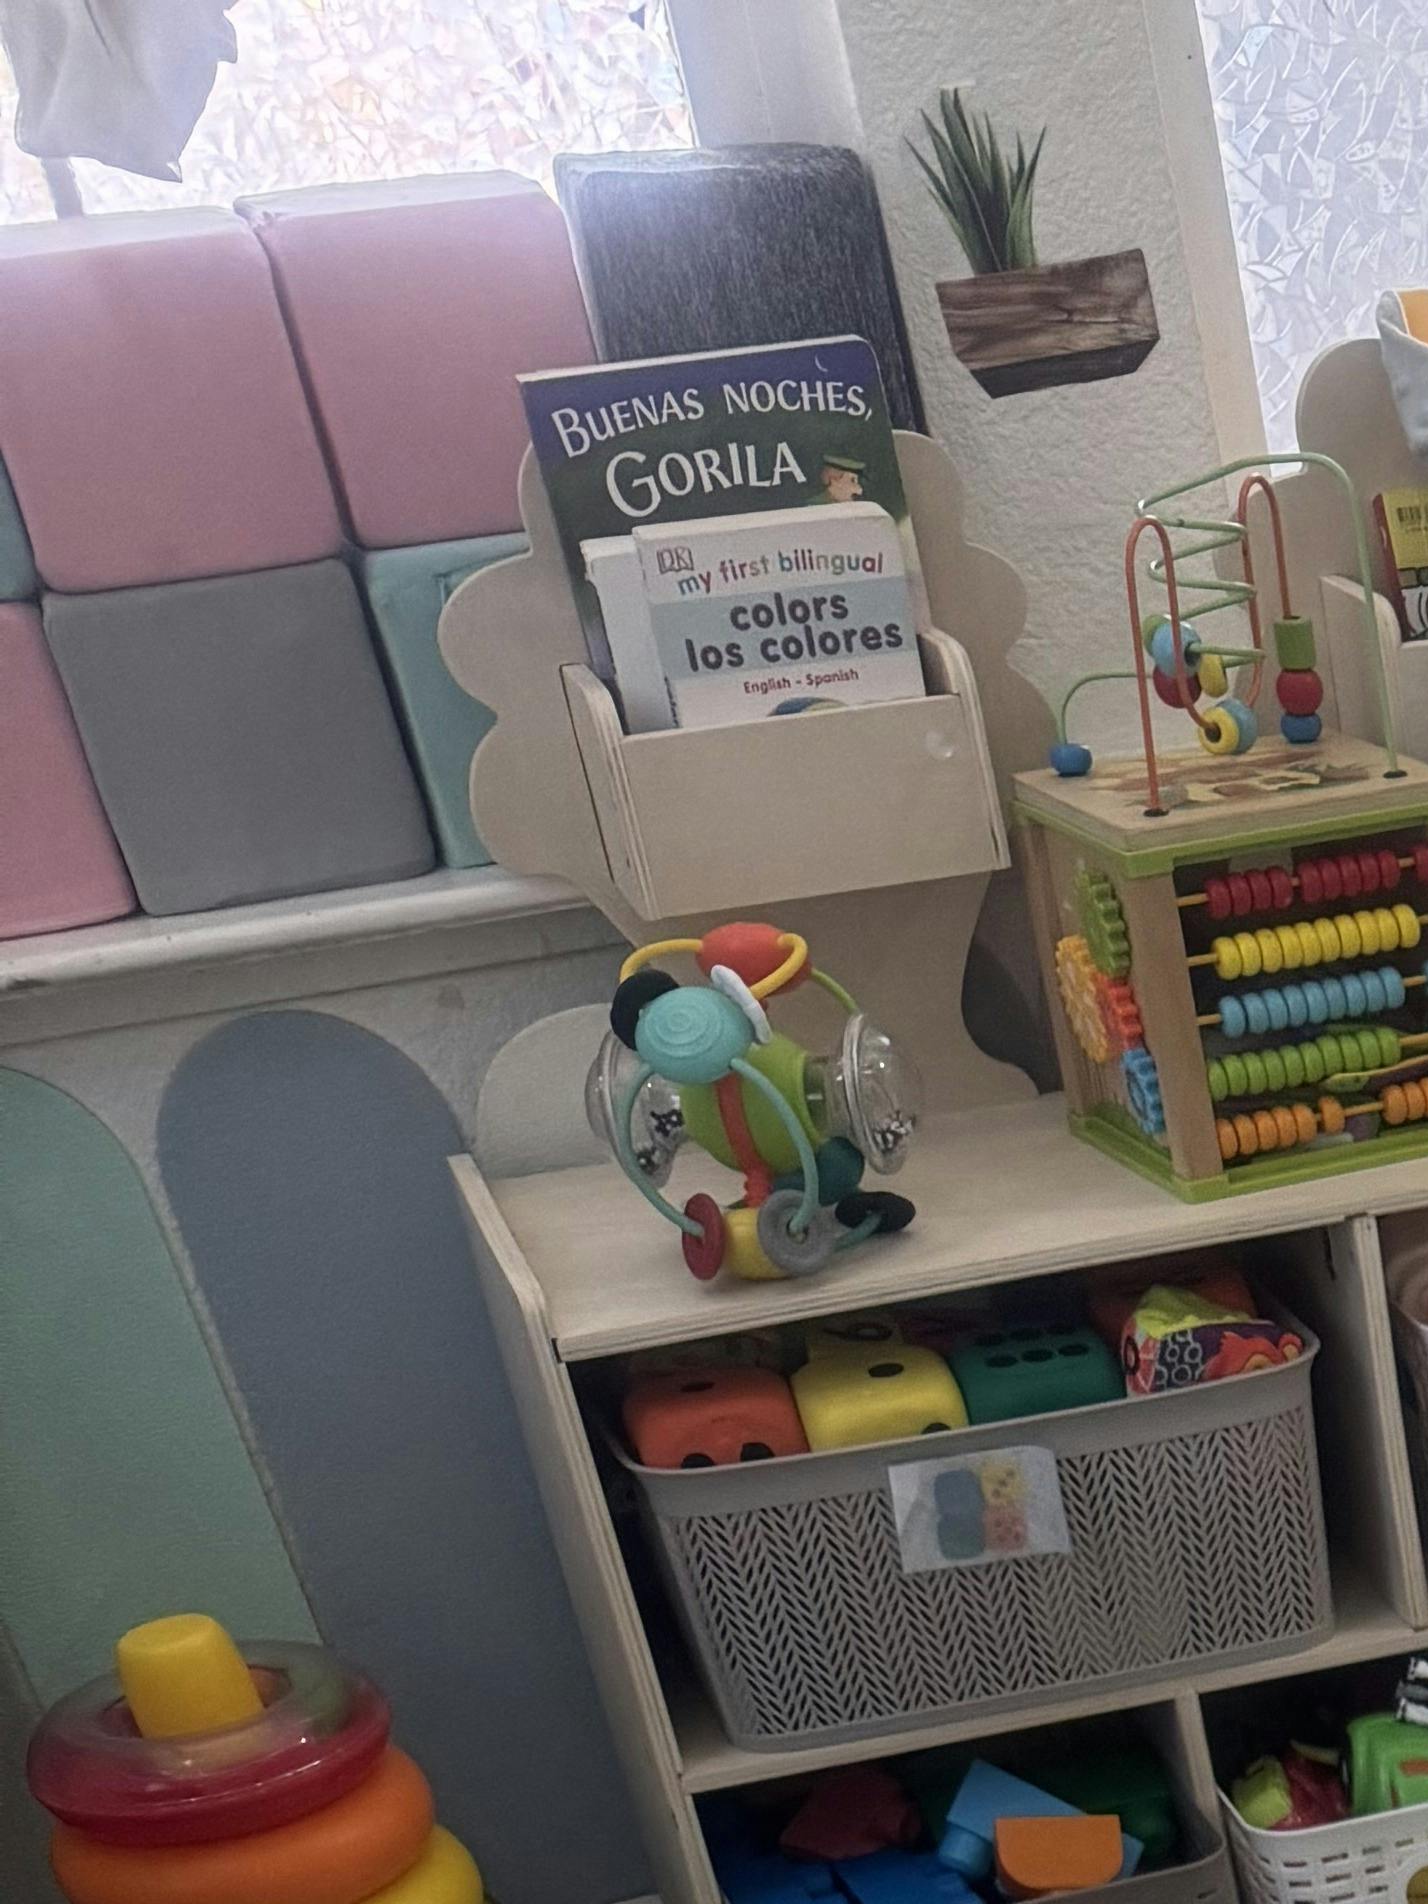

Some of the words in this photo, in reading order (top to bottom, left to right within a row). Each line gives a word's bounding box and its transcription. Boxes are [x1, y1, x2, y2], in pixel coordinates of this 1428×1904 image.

[552, 388, 704, 458] BUENAS
[722, 380, 873, 422] NOCHES,
[606, 442, 806, 518] GORILA
[657, 546, 694, 574] DK
[677, 571, 712, 595] my
[719, 554, 769, 584] first
[778, 548, 883, 576] bilingual
[729, 592, 848, 631] colors
[685, 638, 744, 672] los
[759, 623, 903, 663] colores
[743, 675, 792, 695] English
[806, 668, 859, 691] Spanish
